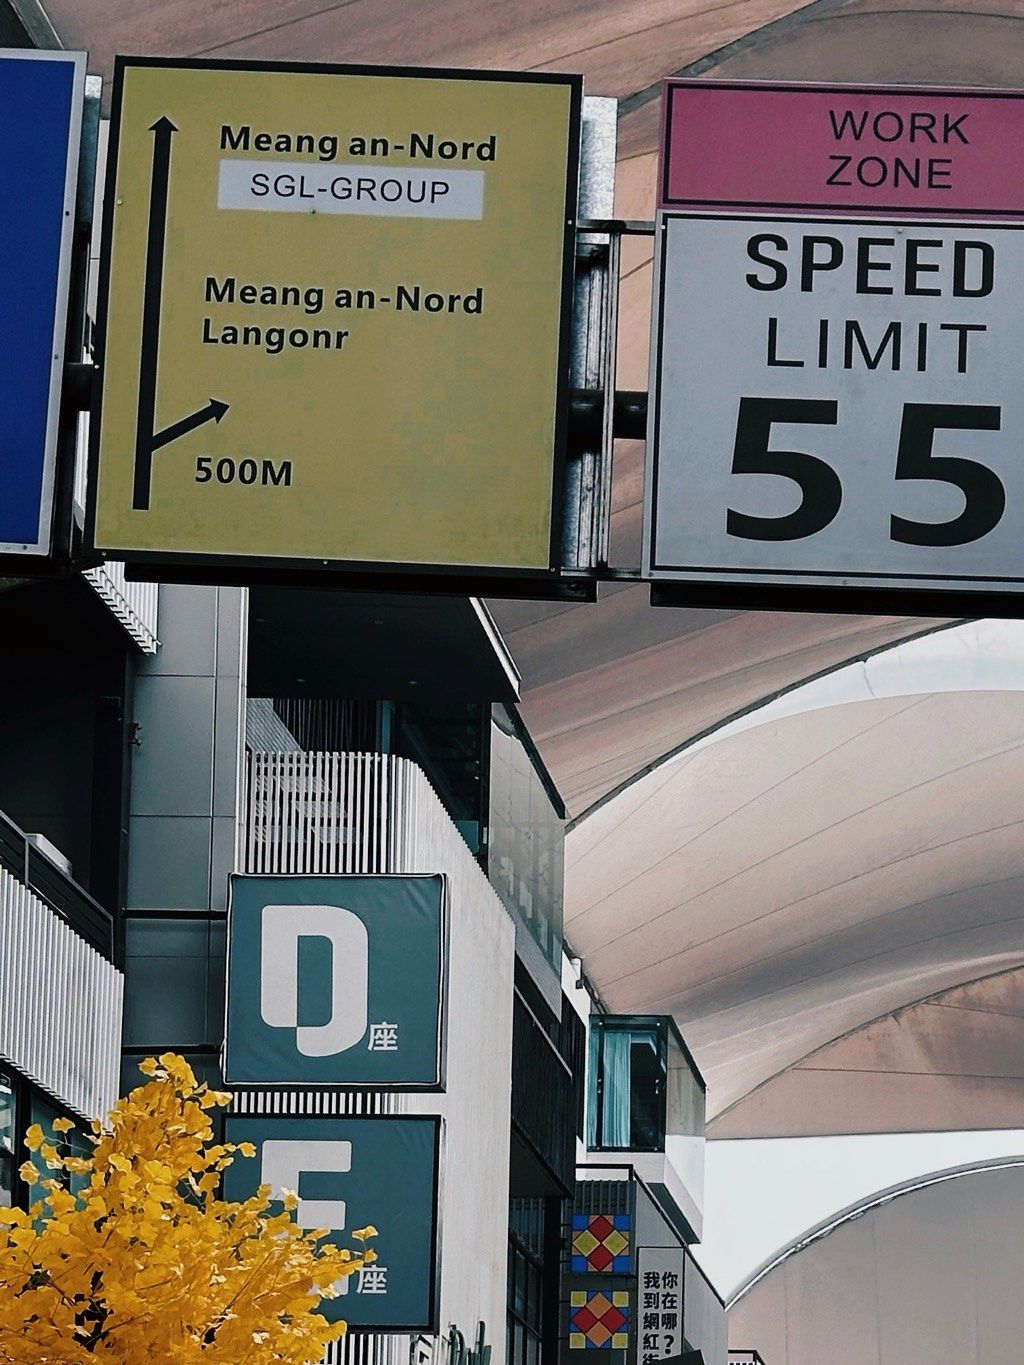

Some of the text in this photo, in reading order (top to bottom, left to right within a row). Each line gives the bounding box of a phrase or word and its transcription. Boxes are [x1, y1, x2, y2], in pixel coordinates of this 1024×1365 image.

[219, 125, 498, 162] Meang an-Nord
[828, 110, 971, 145] WORK
[250, 173, 450, 205] SGL-GROUP
[826, 155, 953, 190] ZONE
[746, 233, 995, 299] SPEED
[204, 277, 484, 315] Meang an-Nord
[202, 319, 349, 355] Langonr
[766, 317, 988, 374] LIMIT
[195, 458, 293, 487] 500M
[726, 396, 1007, 547] 55
[260, 904, 399, 1058] D 座
[661, 1271, 679, 1354] 你在哪?
